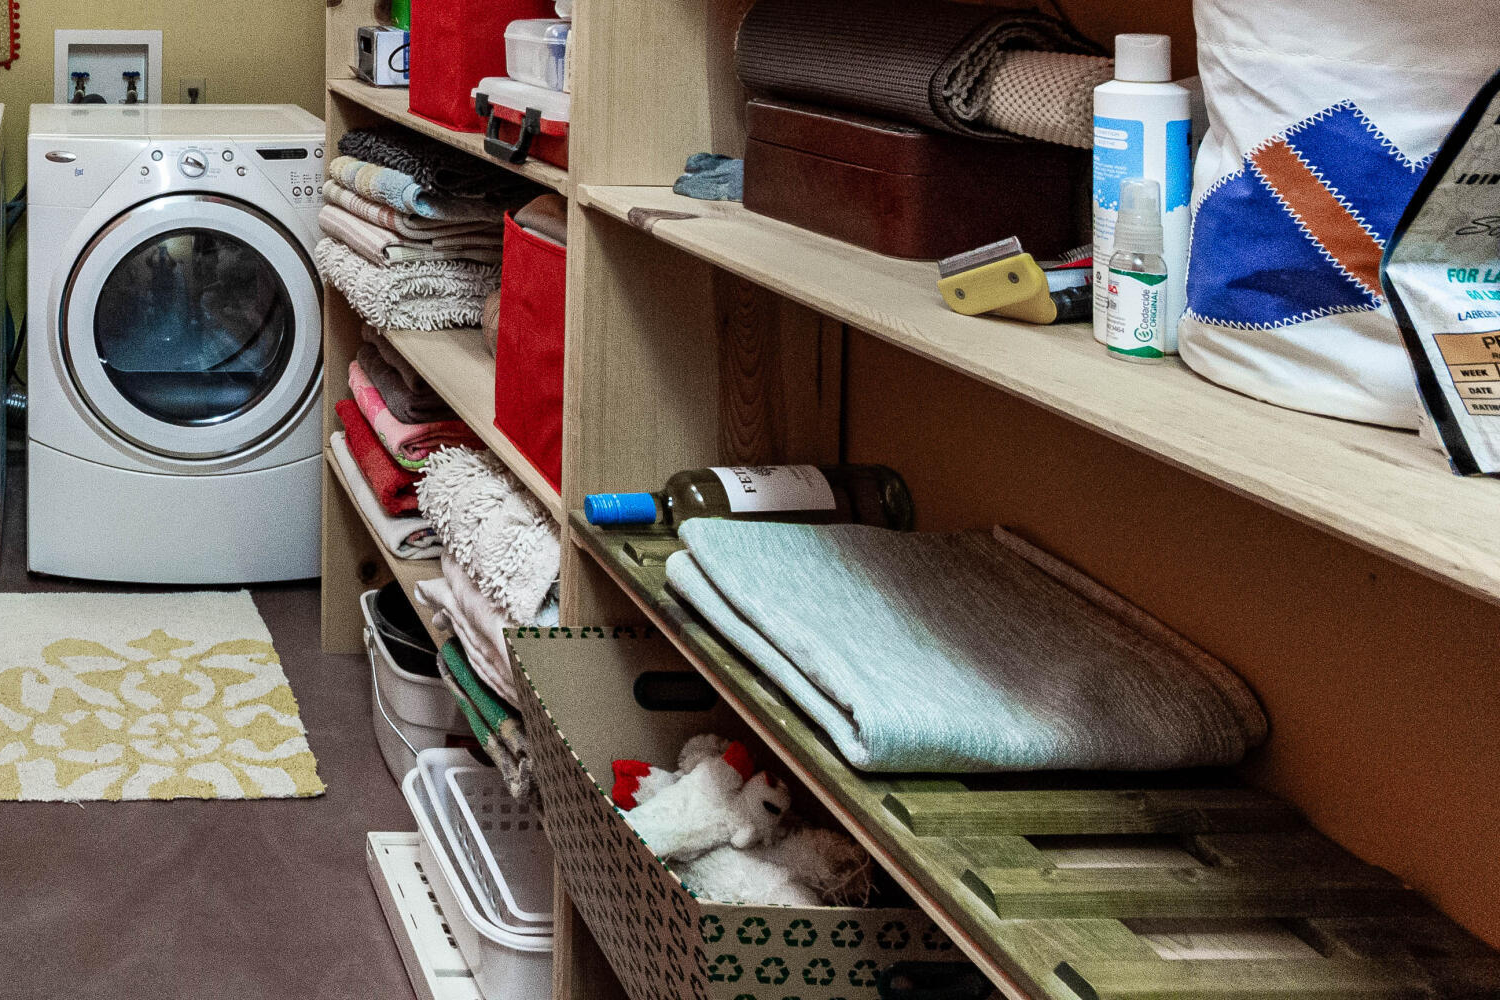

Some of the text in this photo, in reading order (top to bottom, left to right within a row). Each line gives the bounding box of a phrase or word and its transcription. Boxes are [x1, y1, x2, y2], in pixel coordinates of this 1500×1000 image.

[1447, 268, 1480, 284] FOR
[1140, 289, 1151, 330] Cedarcide
[1150, 290, 1158, 328] ORIGINAL
[1460, 368, 1489, 377] WEEK
[1468, 386, 1494, 395] DATE
